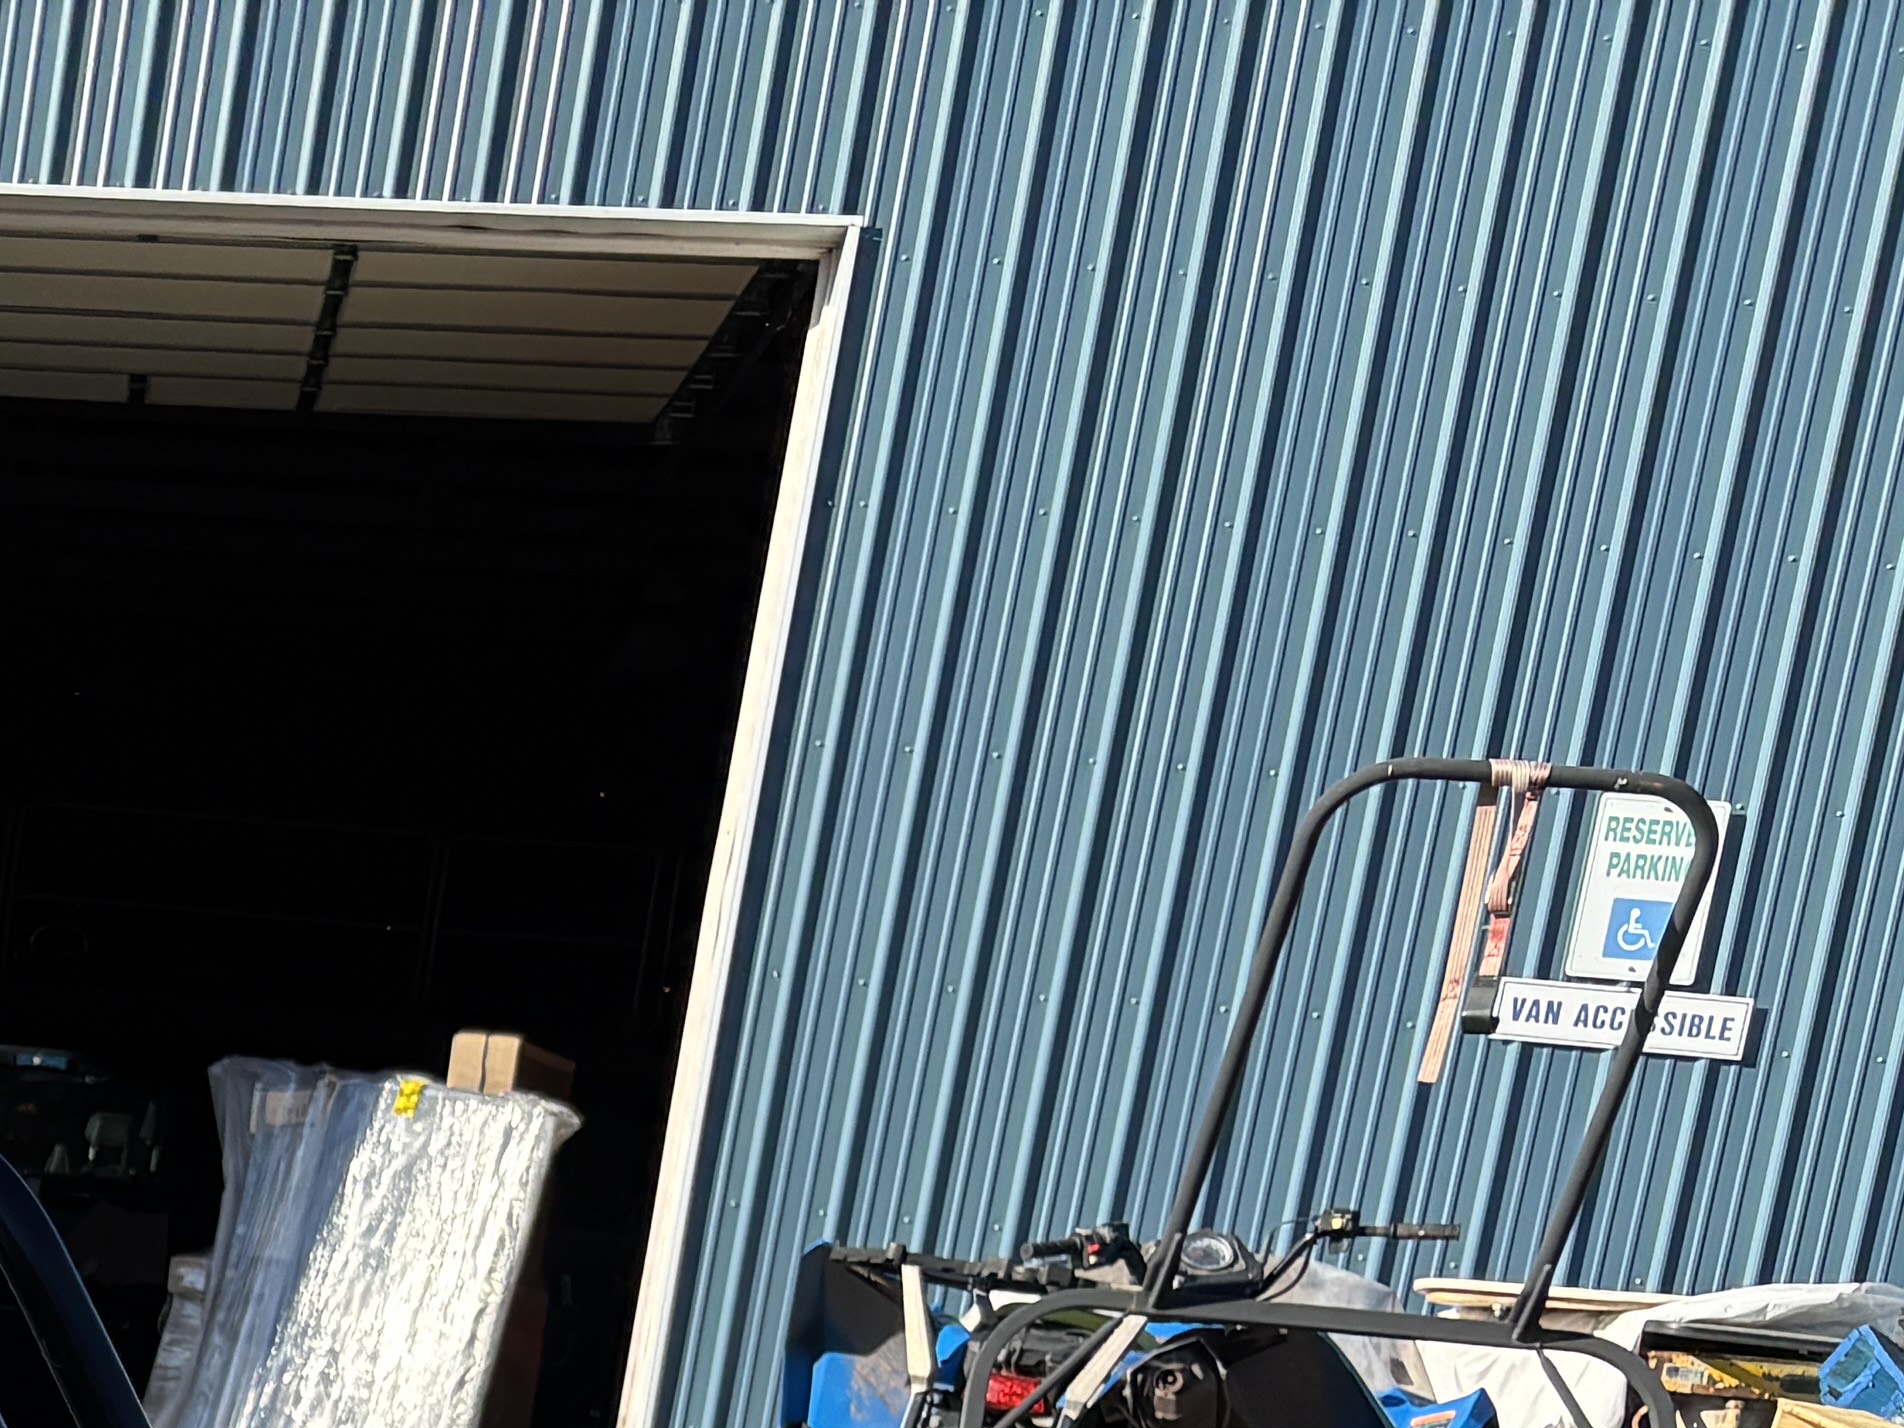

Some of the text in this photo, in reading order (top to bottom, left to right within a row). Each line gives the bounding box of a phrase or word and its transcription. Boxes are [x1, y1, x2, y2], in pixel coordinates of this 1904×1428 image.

[1606, 852, 1688, 882] PARKIN
[1511, 996, 1736, 1043] VAN ACCSIBLE
